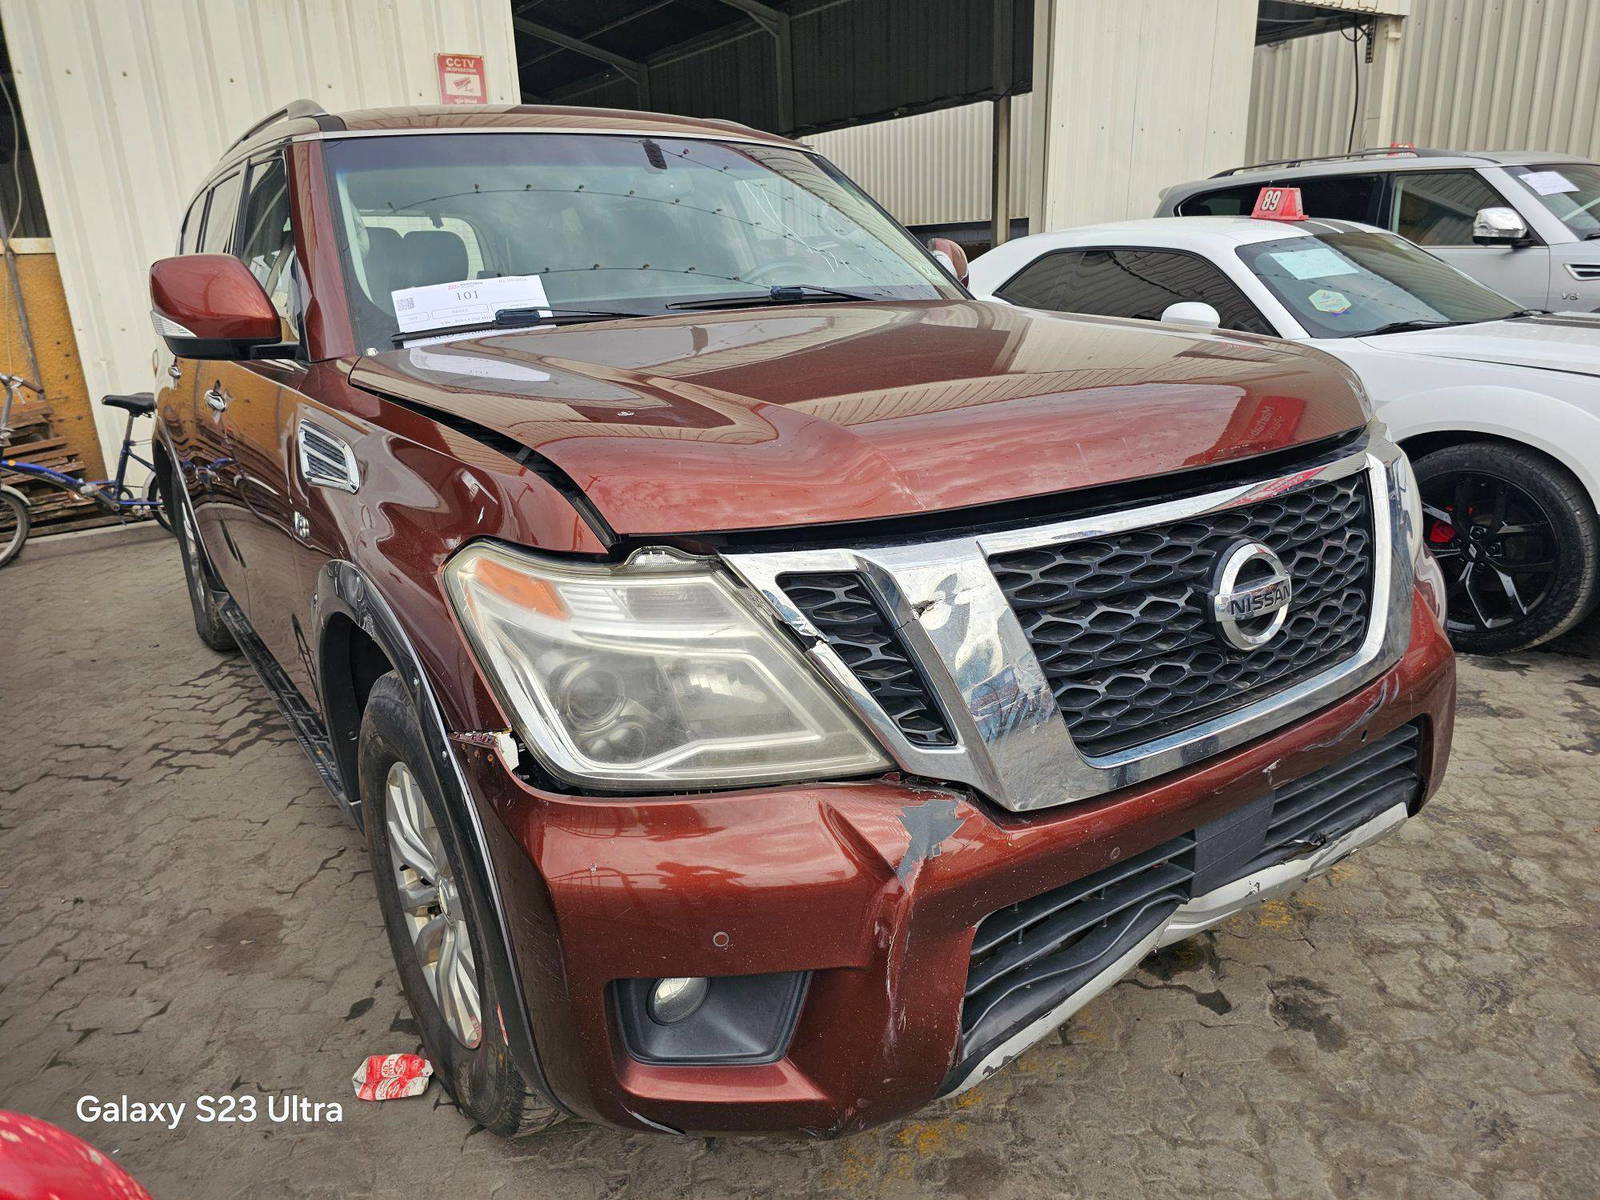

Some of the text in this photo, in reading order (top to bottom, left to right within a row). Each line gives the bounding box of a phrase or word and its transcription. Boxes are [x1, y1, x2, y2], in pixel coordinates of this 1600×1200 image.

[446, 57, 475, 69] CCTV
[1261, 190, 1281, 211] 89
[457, 290, 478, 301] 101
[1230, 584, 1291, 617] NISSAN
